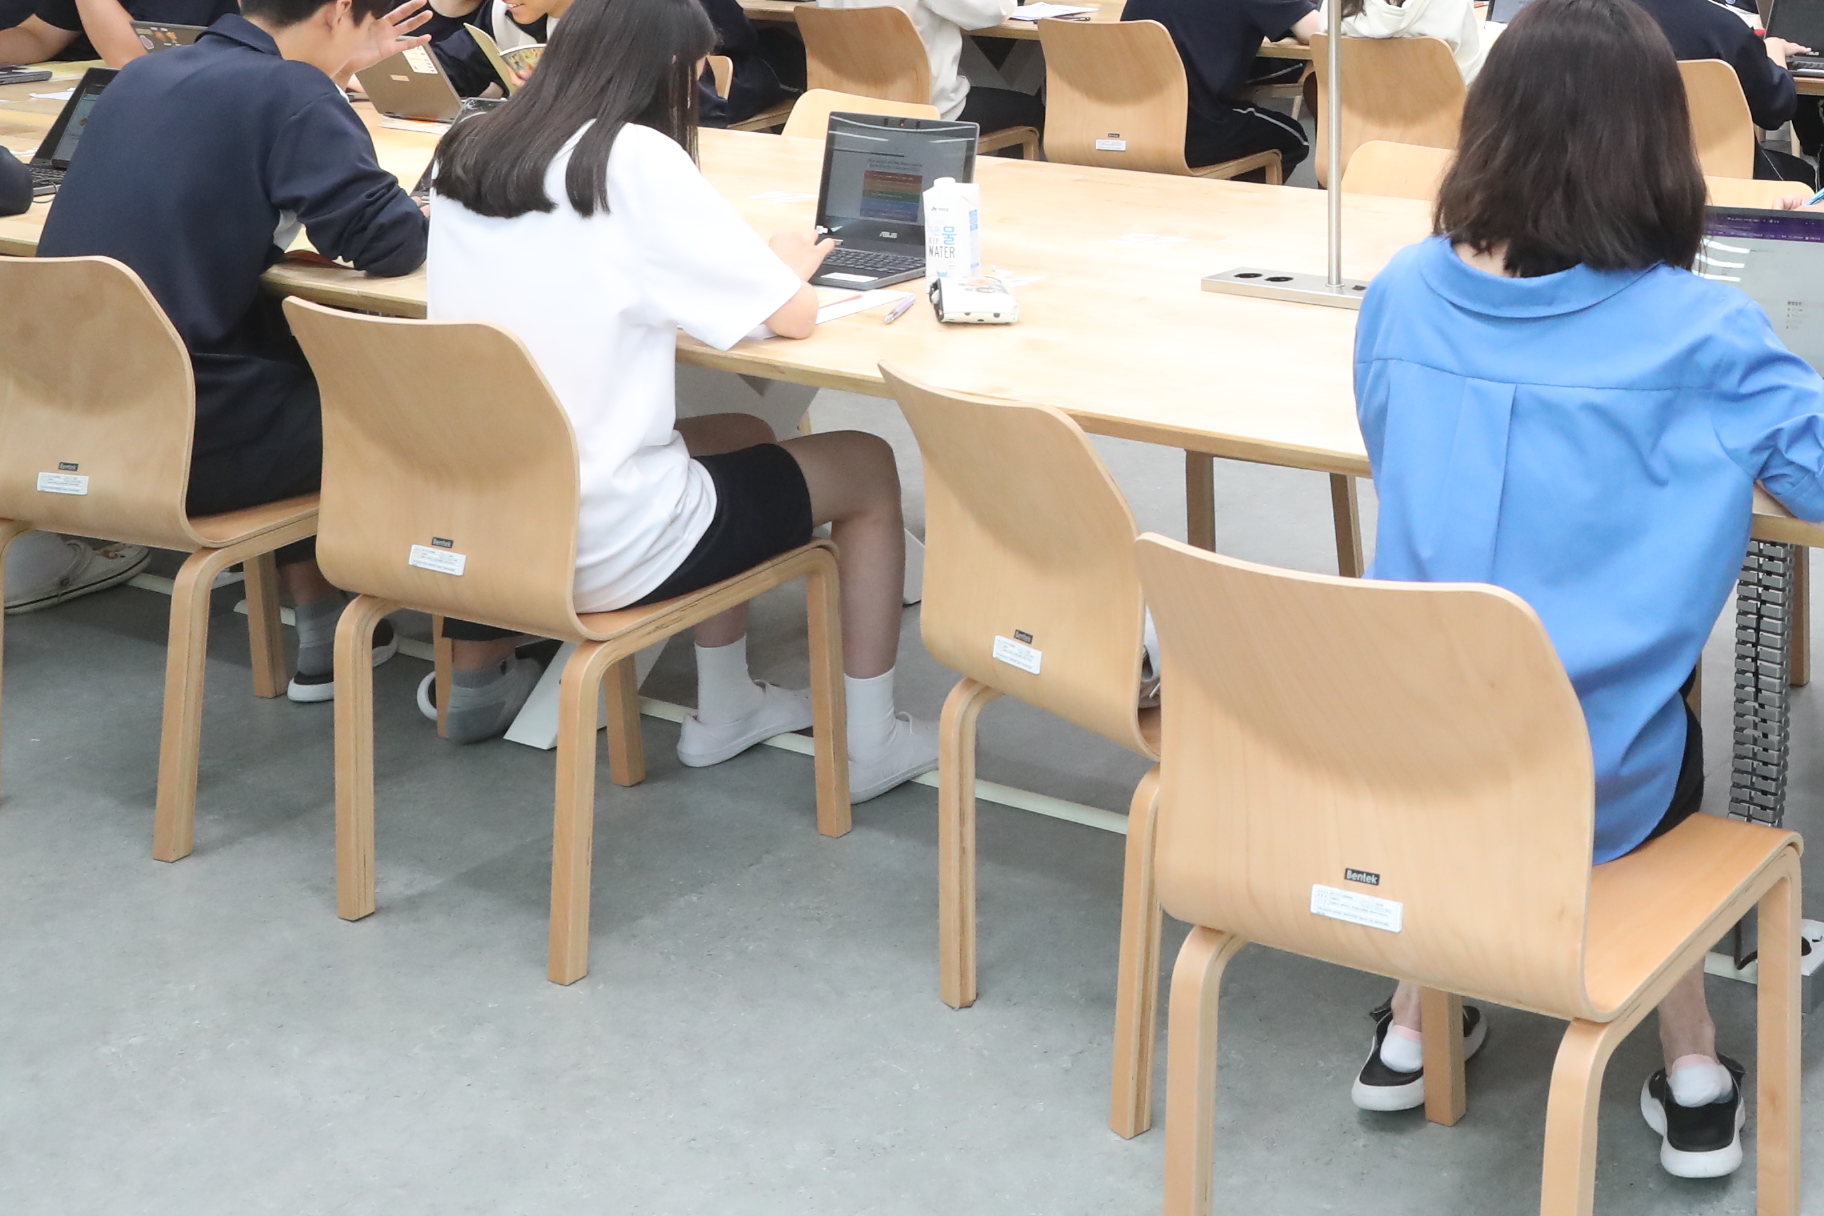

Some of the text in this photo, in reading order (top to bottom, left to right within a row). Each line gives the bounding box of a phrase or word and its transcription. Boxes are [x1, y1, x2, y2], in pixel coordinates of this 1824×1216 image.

[941, 226, 957, 245] 물
[928, 246, 956, 259] WATER
[1346, 869, 1379, 884] Bentek
